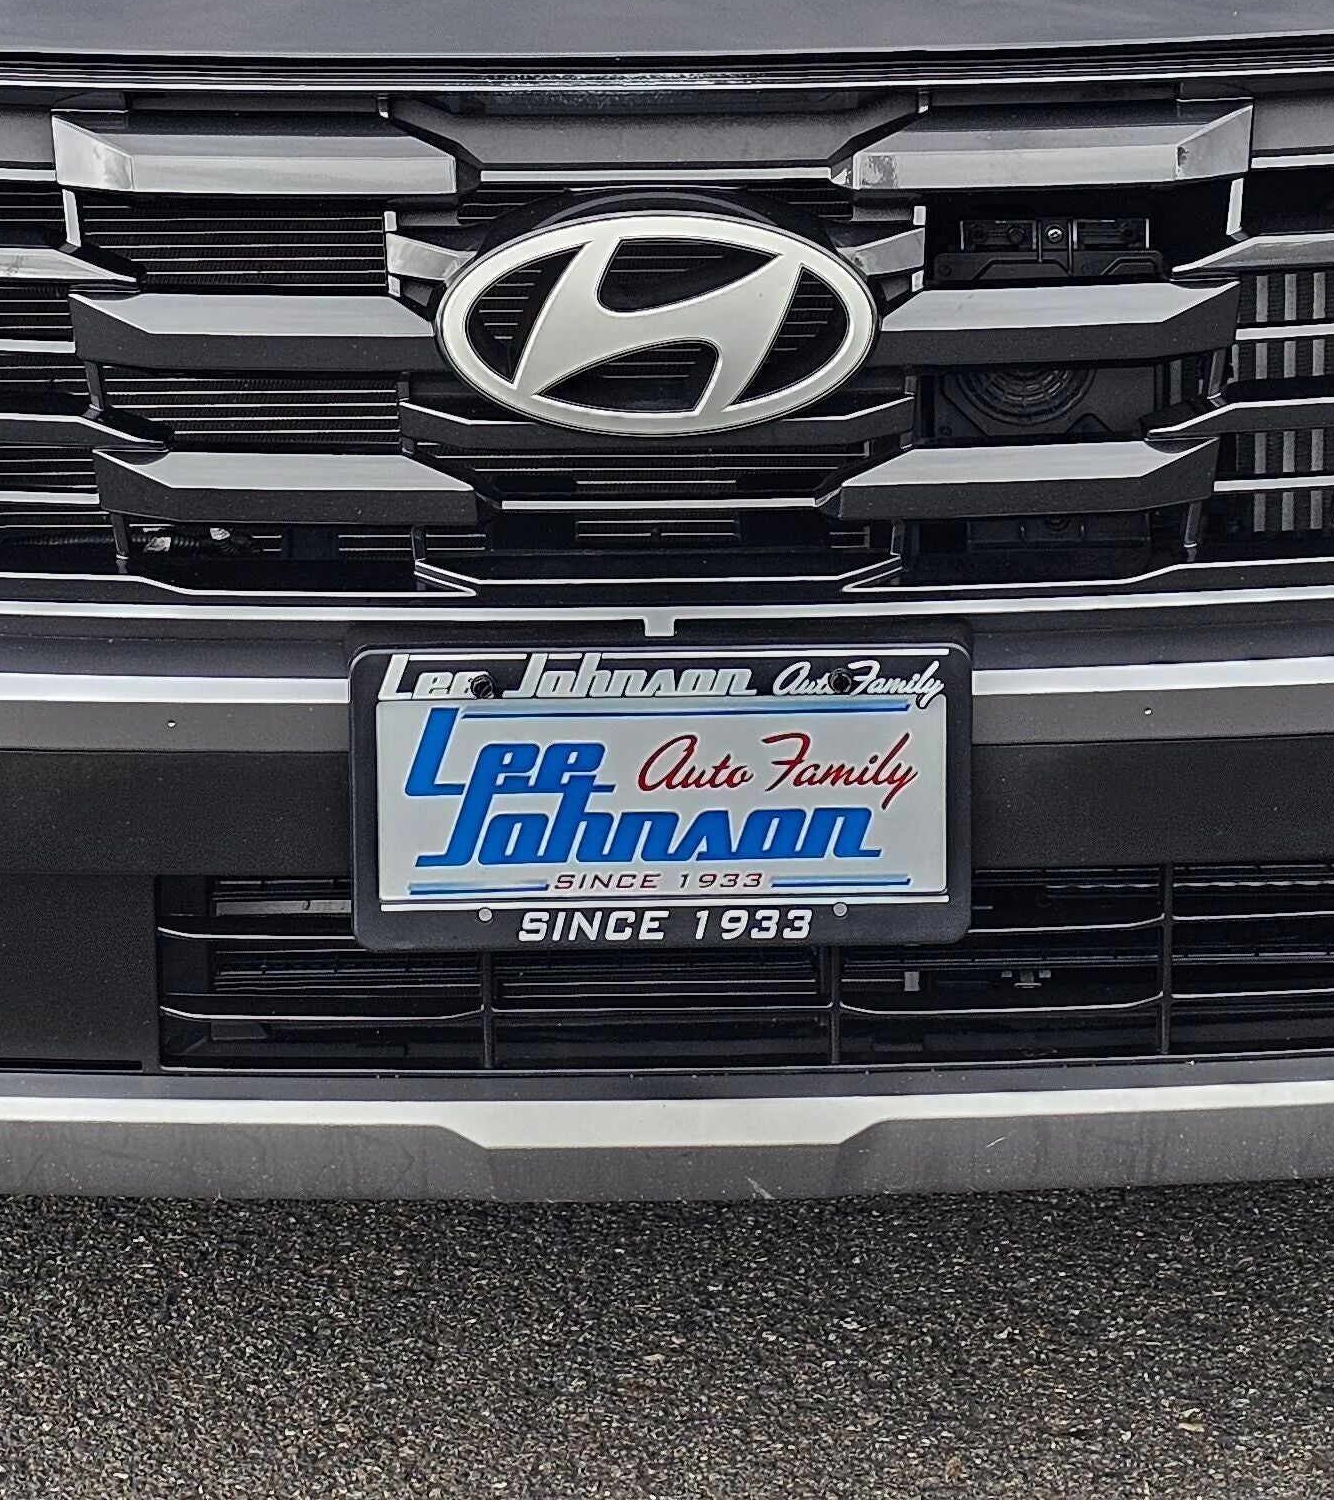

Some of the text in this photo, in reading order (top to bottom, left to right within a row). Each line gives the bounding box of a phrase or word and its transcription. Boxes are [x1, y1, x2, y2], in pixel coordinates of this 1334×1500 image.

[378, 654, 494, 699] Lee
[502, 652, 757, 699] Johnson
[847, 660, 945, 708] Family
[405, 707, 918, 810] Lee Auto Family
[415, 775, 882, 867] Johnson
[554, 872, 763, 890] SINCE 1933
[518, 909, 813, 941] SINCE 1933
